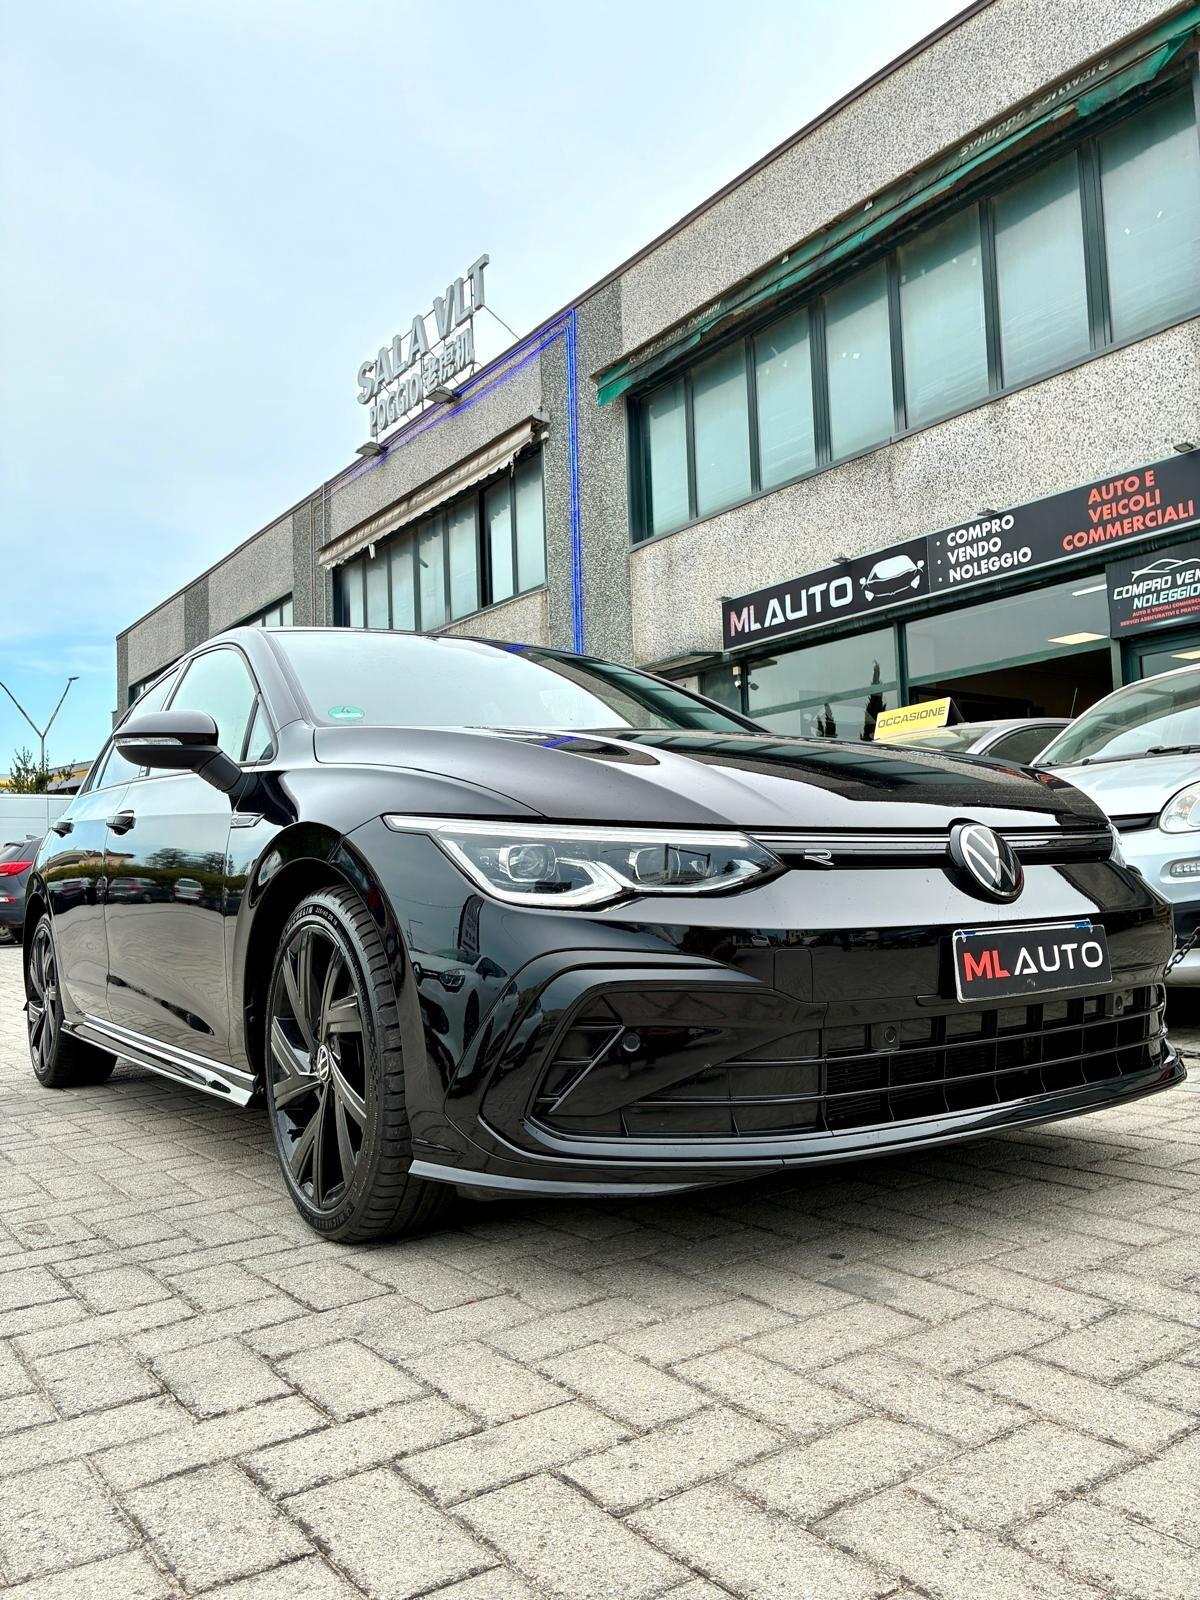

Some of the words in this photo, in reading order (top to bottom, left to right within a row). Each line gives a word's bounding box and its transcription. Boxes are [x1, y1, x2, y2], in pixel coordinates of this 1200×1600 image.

[958, 109, 1025, 158] Sviluppo
[357, 314, 430, 405] SALA
[433, 253, 489, 340] VLT
[369, 373, 423, 437] POGGIO
[1088, 475, 1140, 505] AUTO
[1145, 470, 1155, 487] E
[1088, 489, 1161, 524] VEICOLI
[946, 514, 1015, 547] COMPRO
[1062, 500, 1195, 551] COMMERCIALI
[947, 537, 1002, 565] VENDO
[949, 547, 1032, 583] NOLEGGIO
[1113, 576, 1172, 600] COMPRO
[1133, 583, 1200, 610] NOLEGGIO
[877, 706, 946, 729] OCCASIONE
